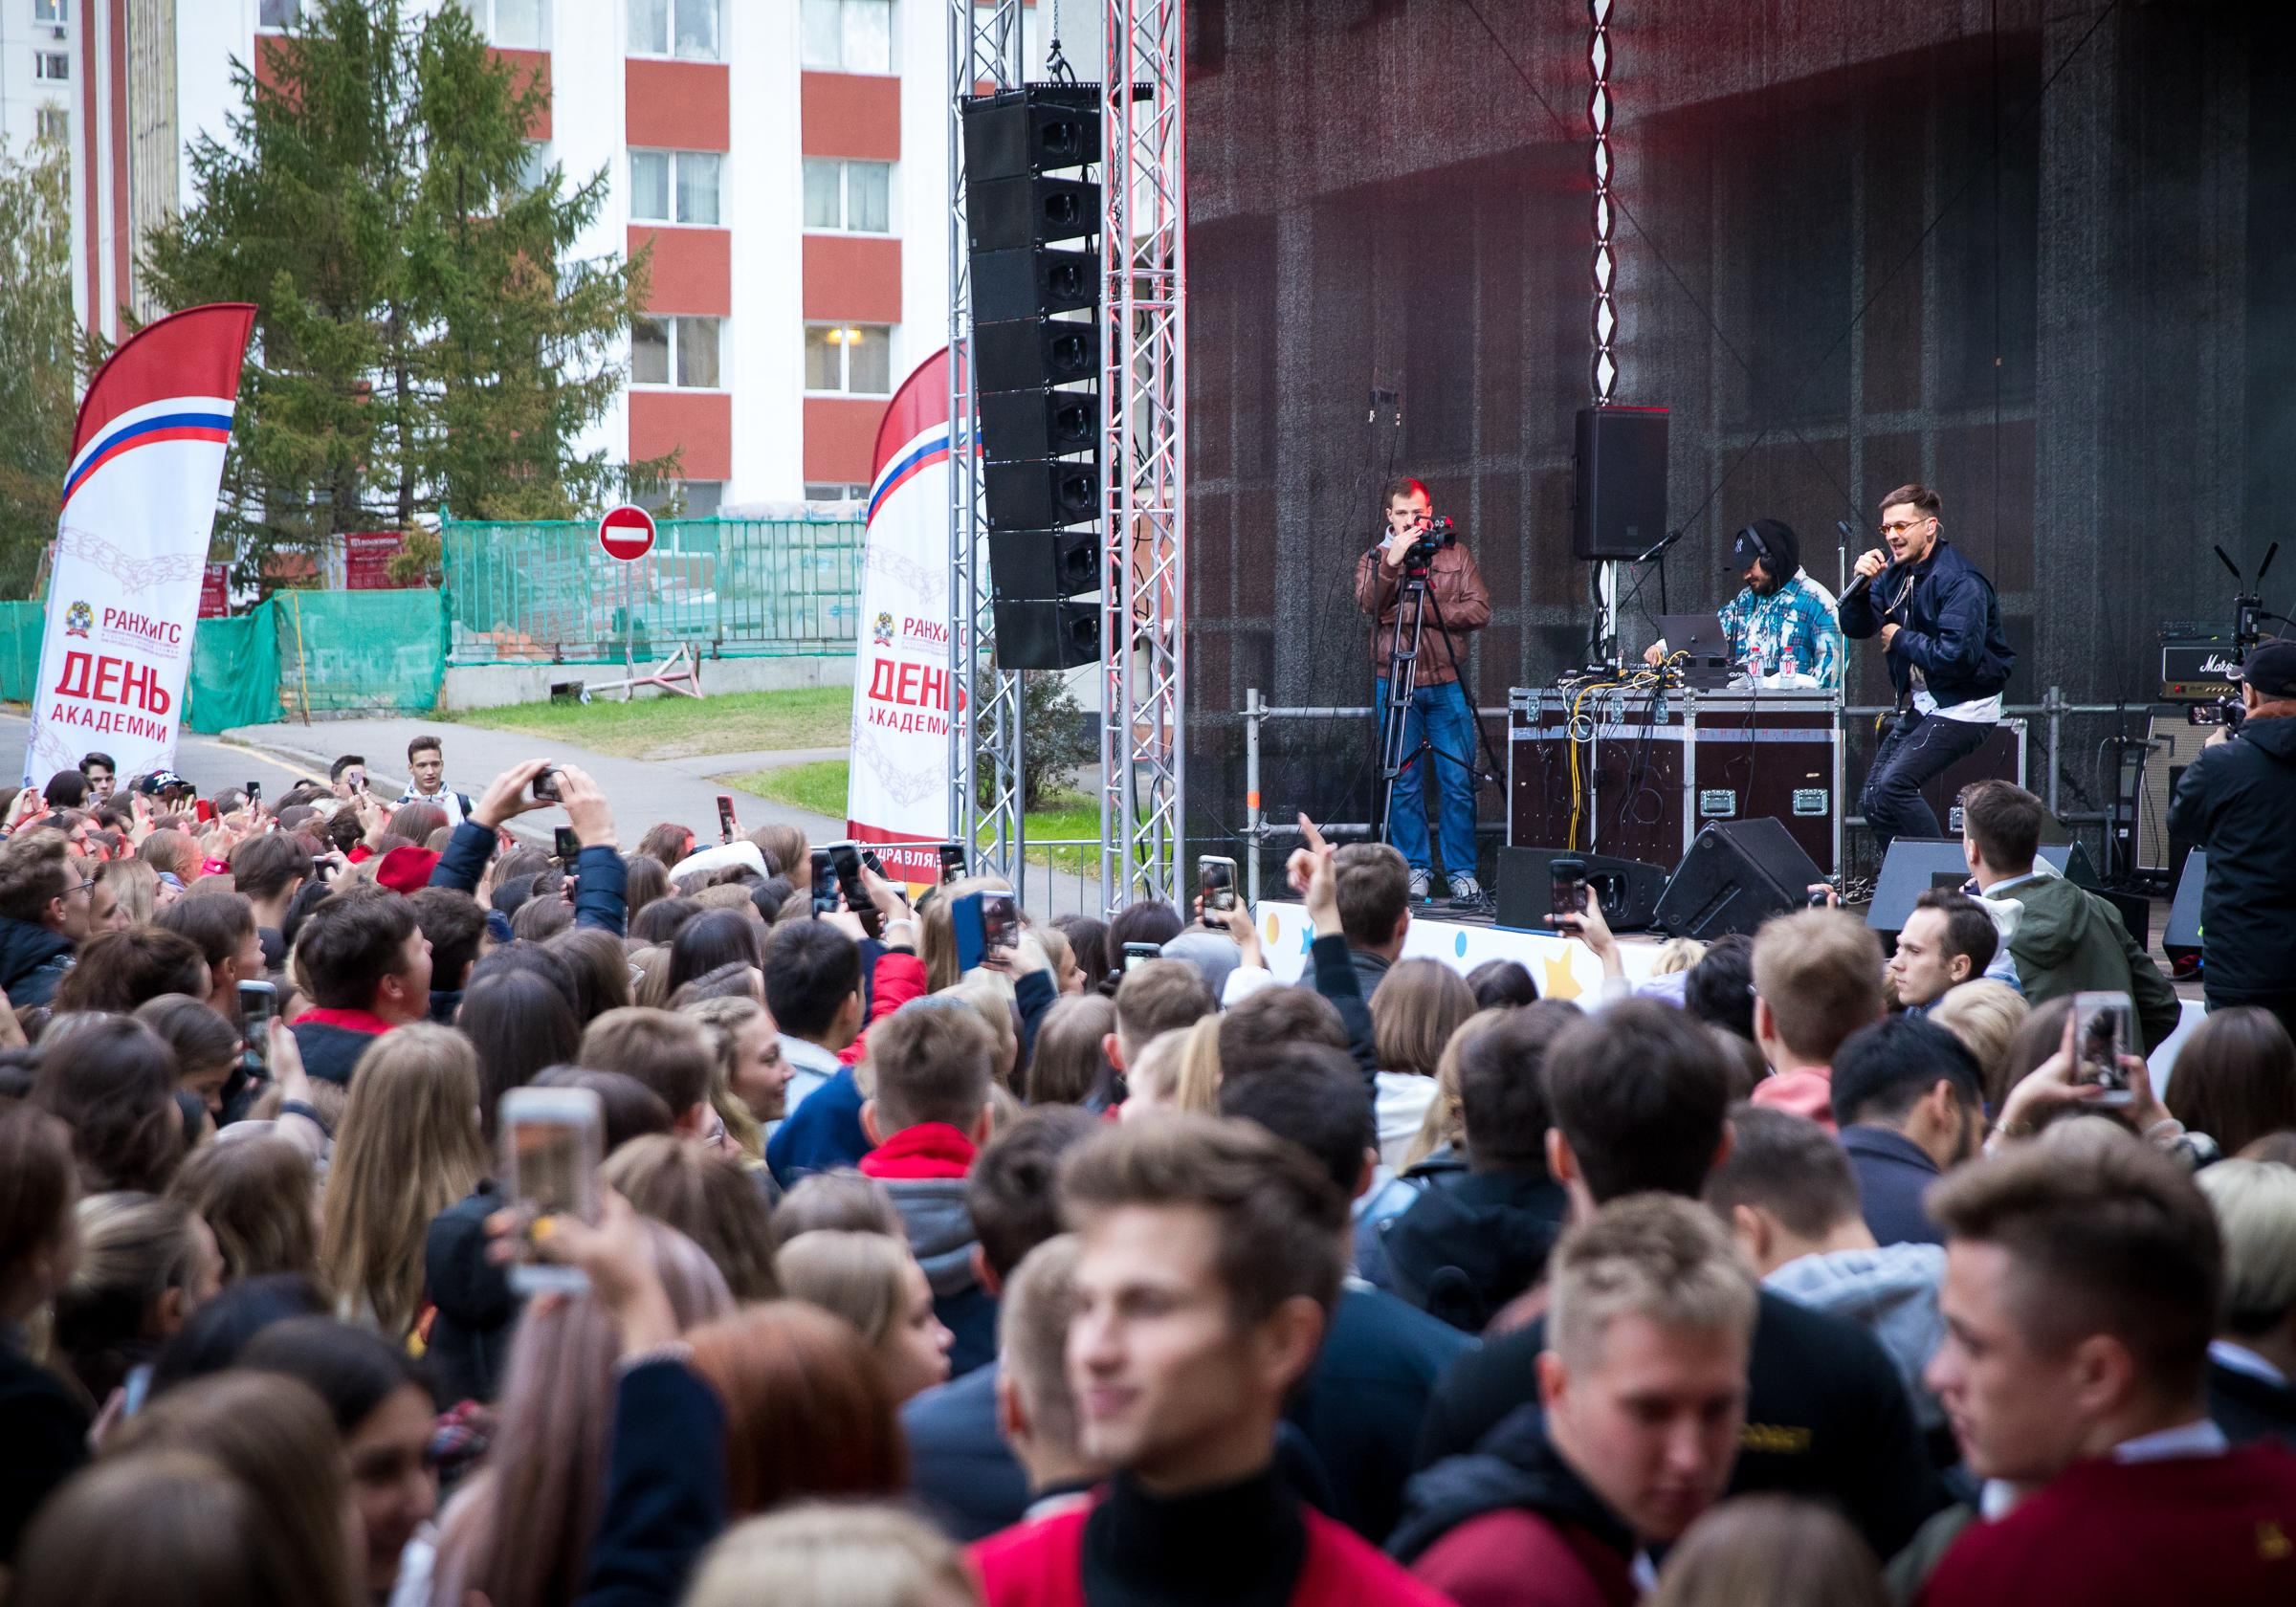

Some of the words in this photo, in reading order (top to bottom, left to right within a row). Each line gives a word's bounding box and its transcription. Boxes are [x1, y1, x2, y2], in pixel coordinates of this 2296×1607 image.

[103, 607, 182, 644] РАНХиГС
[2198, 653, 2234, 672] Mars
[55, 650, 170, 715] ДЕНЬ
[51, 703, 167, 743] АКАДЕМИИ
